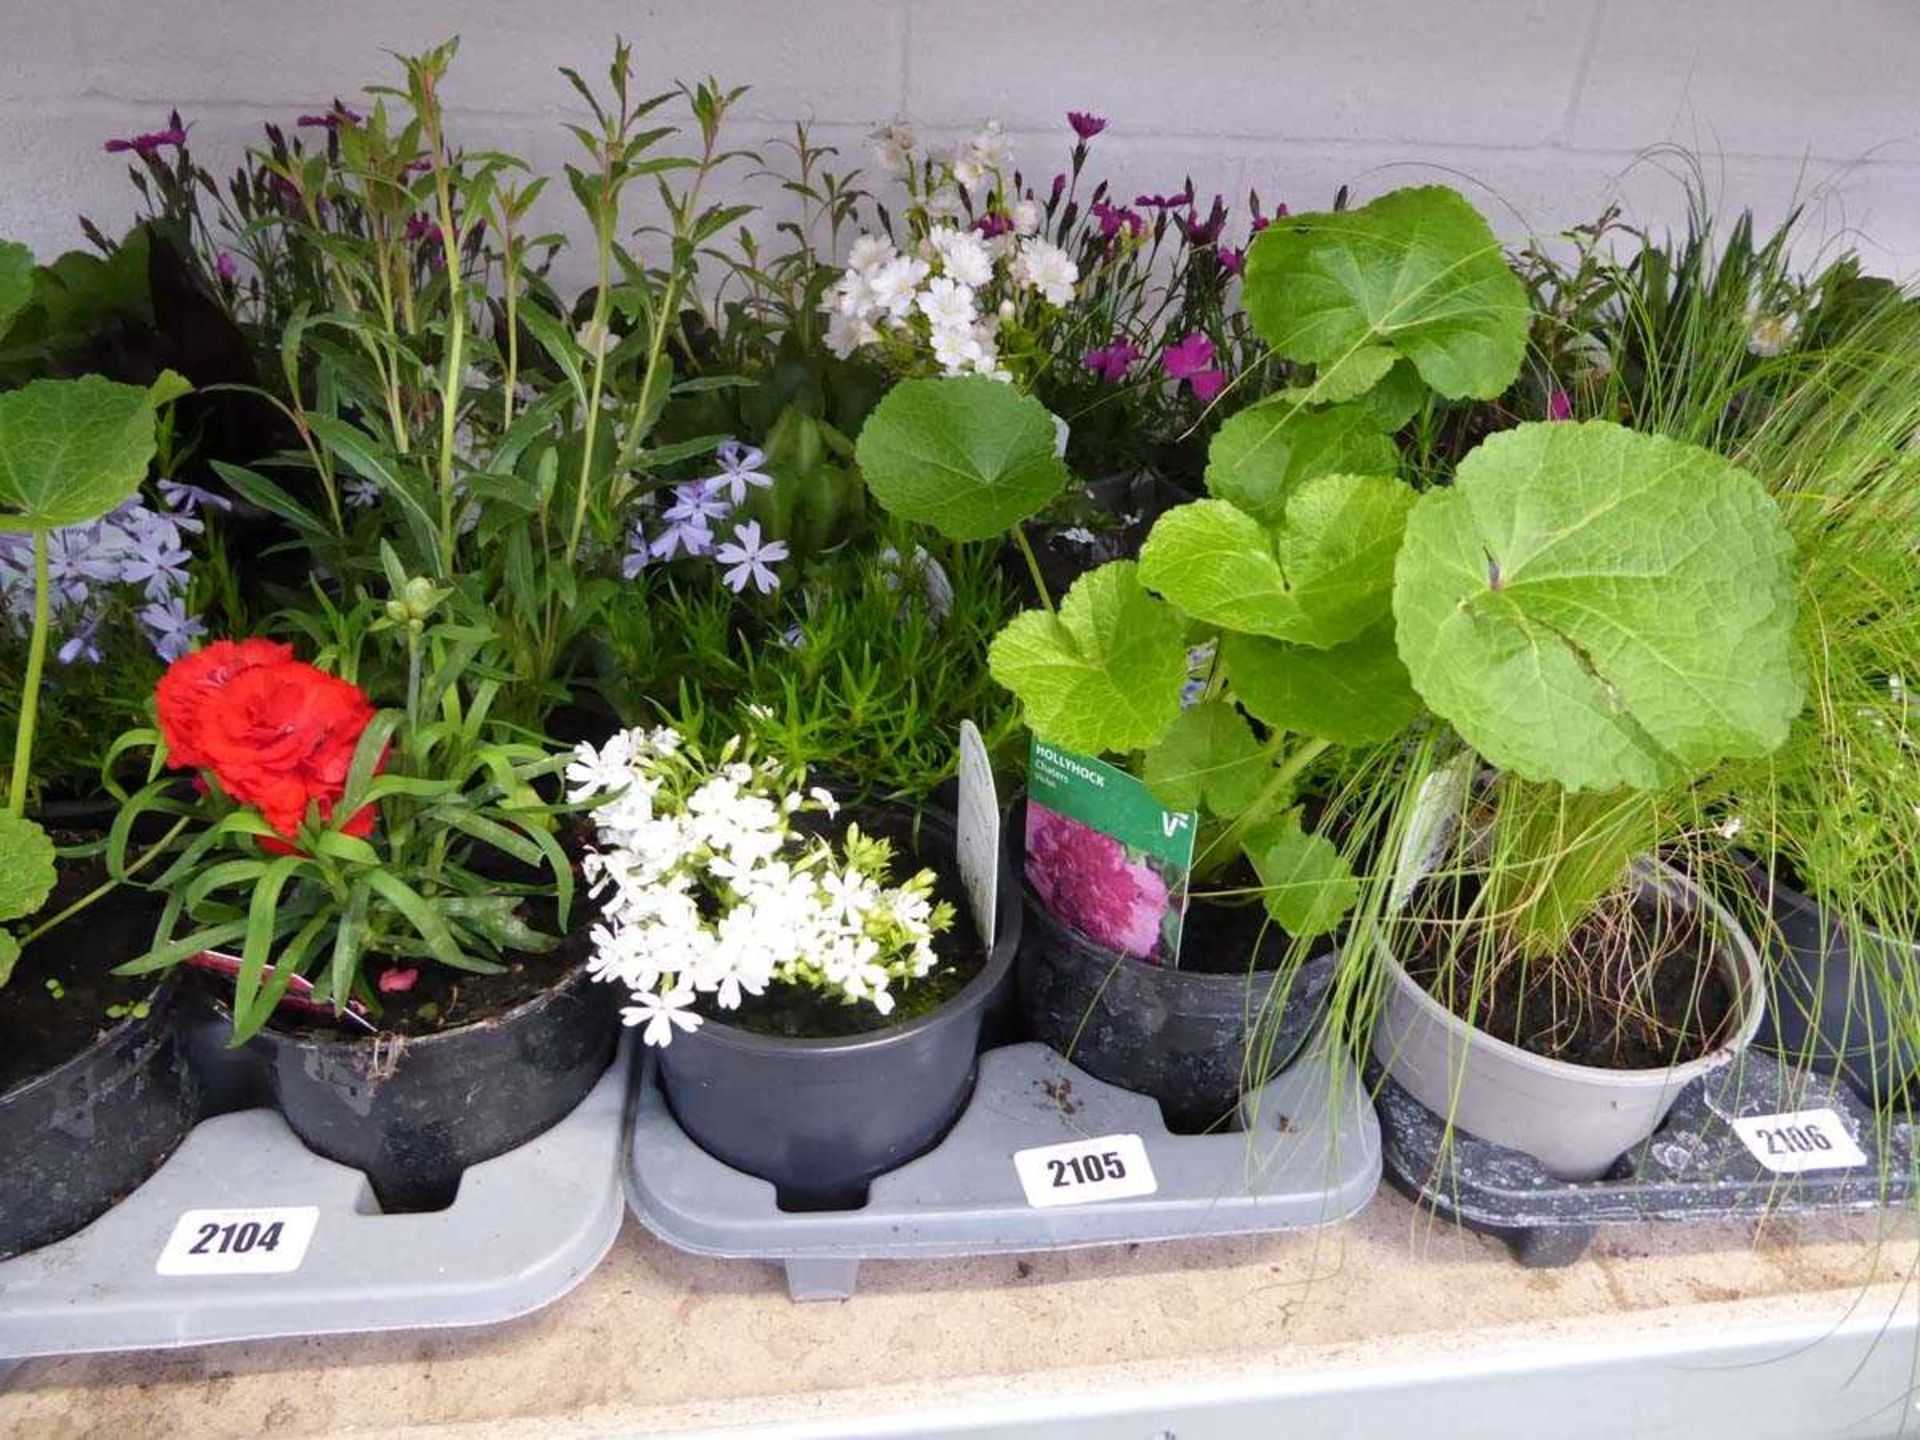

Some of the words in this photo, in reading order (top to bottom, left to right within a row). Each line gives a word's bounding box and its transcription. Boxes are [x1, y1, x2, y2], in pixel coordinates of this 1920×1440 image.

[1036, 743, 1104, 787] HOLLYHOCK
[1757, 1124, 1832, 1155] 2106
[1047, 1152, 1126, 1187] 2105
[188, 1220, 284, 1254] 2104
